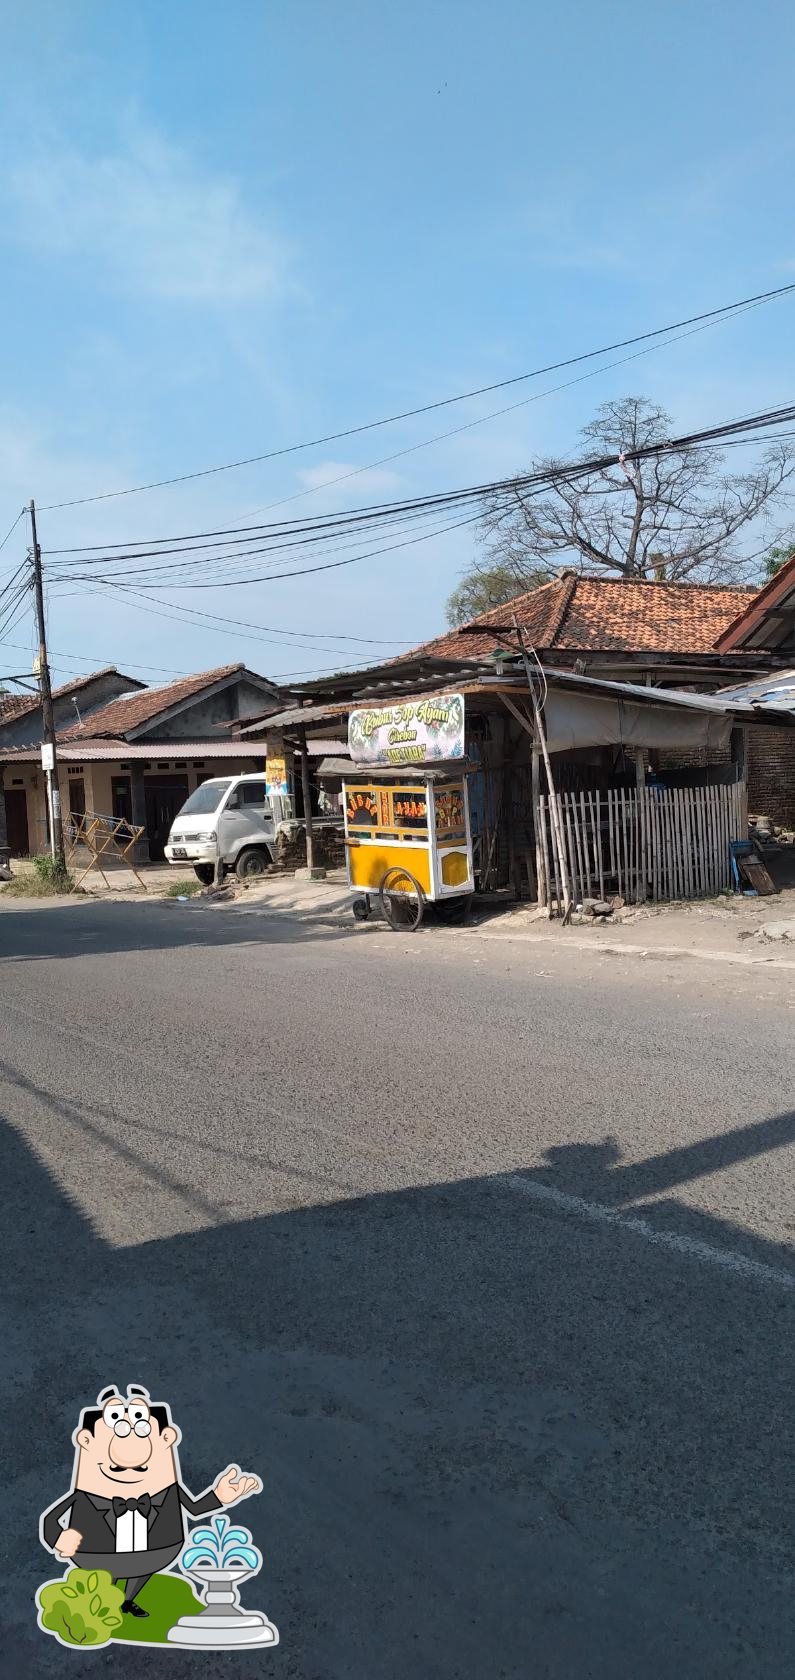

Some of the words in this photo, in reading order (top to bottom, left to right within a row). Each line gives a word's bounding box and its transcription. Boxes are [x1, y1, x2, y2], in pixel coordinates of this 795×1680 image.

[394, 704, 414, 727] Sop
[415, 701, 449, 726] Ayam
[388, 727, 417, 745] Cirebon
